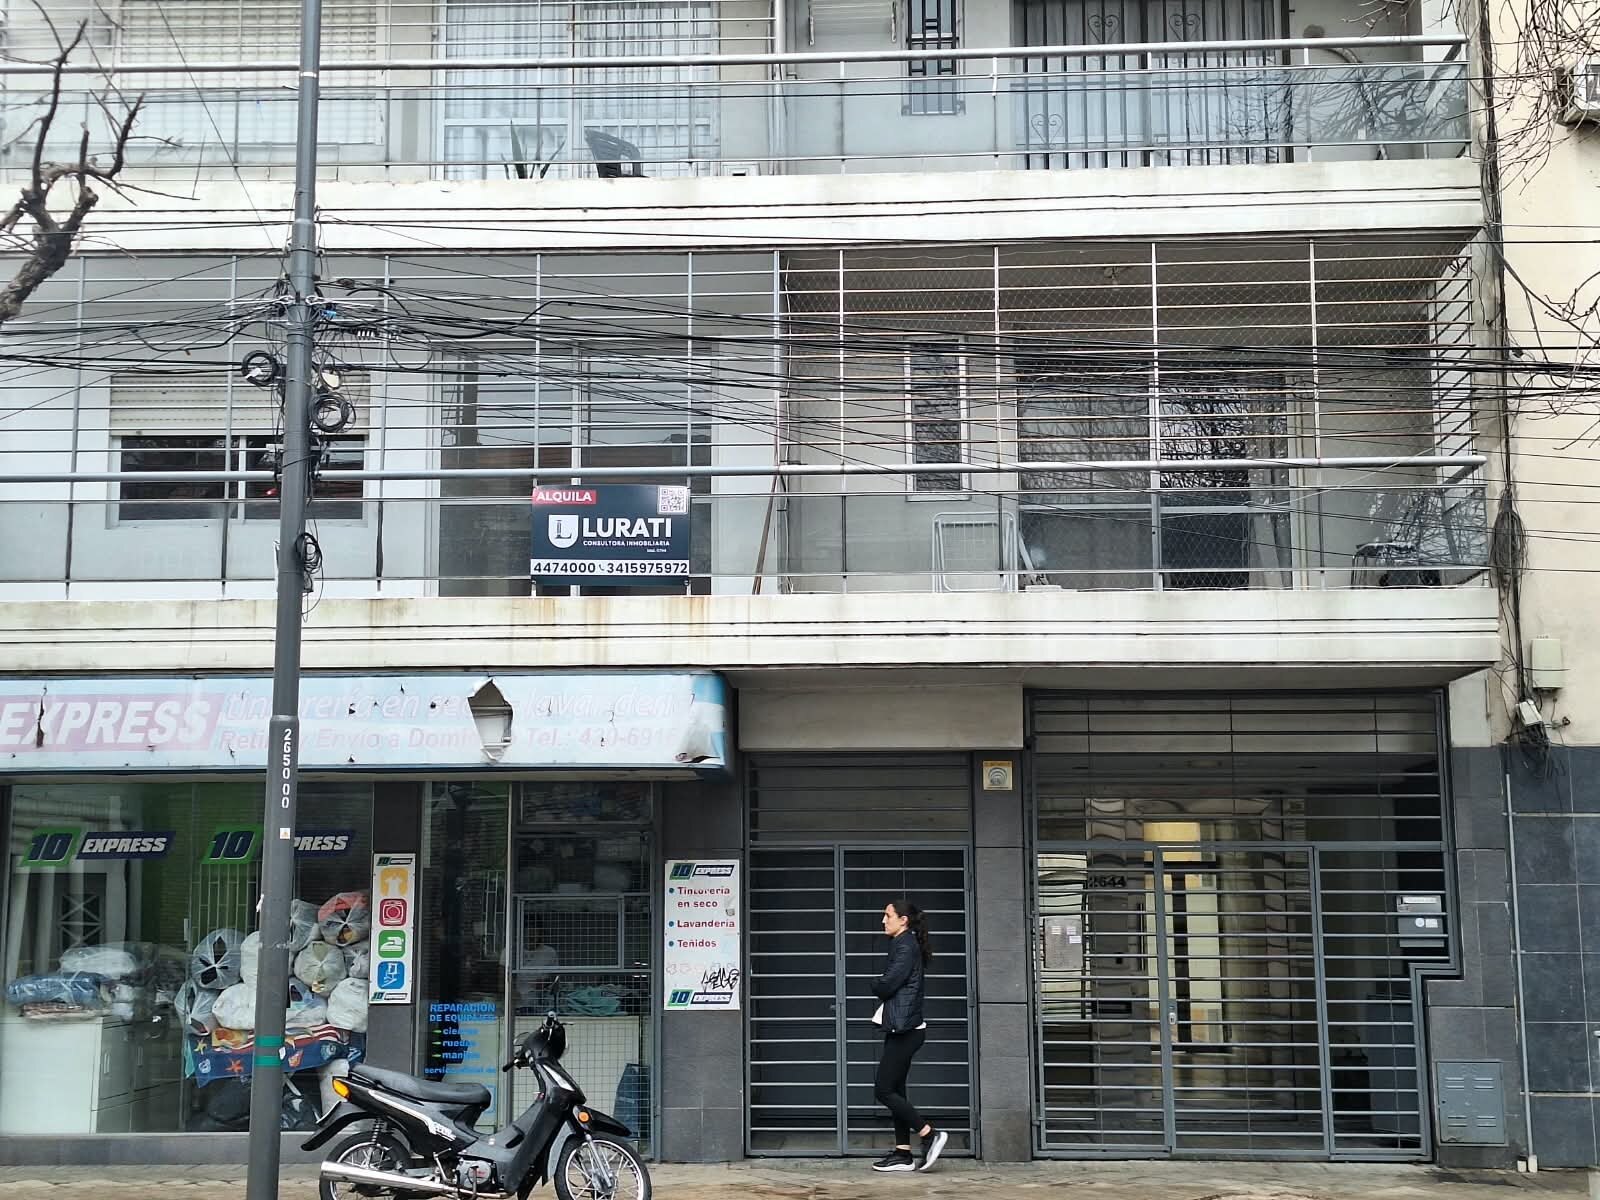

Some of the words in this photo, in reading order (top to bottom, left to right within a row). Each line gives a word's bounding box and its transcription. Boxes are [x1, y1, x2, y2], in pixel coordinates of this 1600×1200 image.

[537, 491, 592, 502] ALQUILA
[583, 518, 672, 538] LURATI
[533, 563, 596, 573] 4474000
[607, 563, 688, 573] 3415975972
[0, 701, 211, 745] EXPRESS
[28, 833, 73, 861] 10
[82, 837, 167, 853] EXPRESS
[210, 831, 256, 859] 10
[429, 1014, 442, 1022] DE
